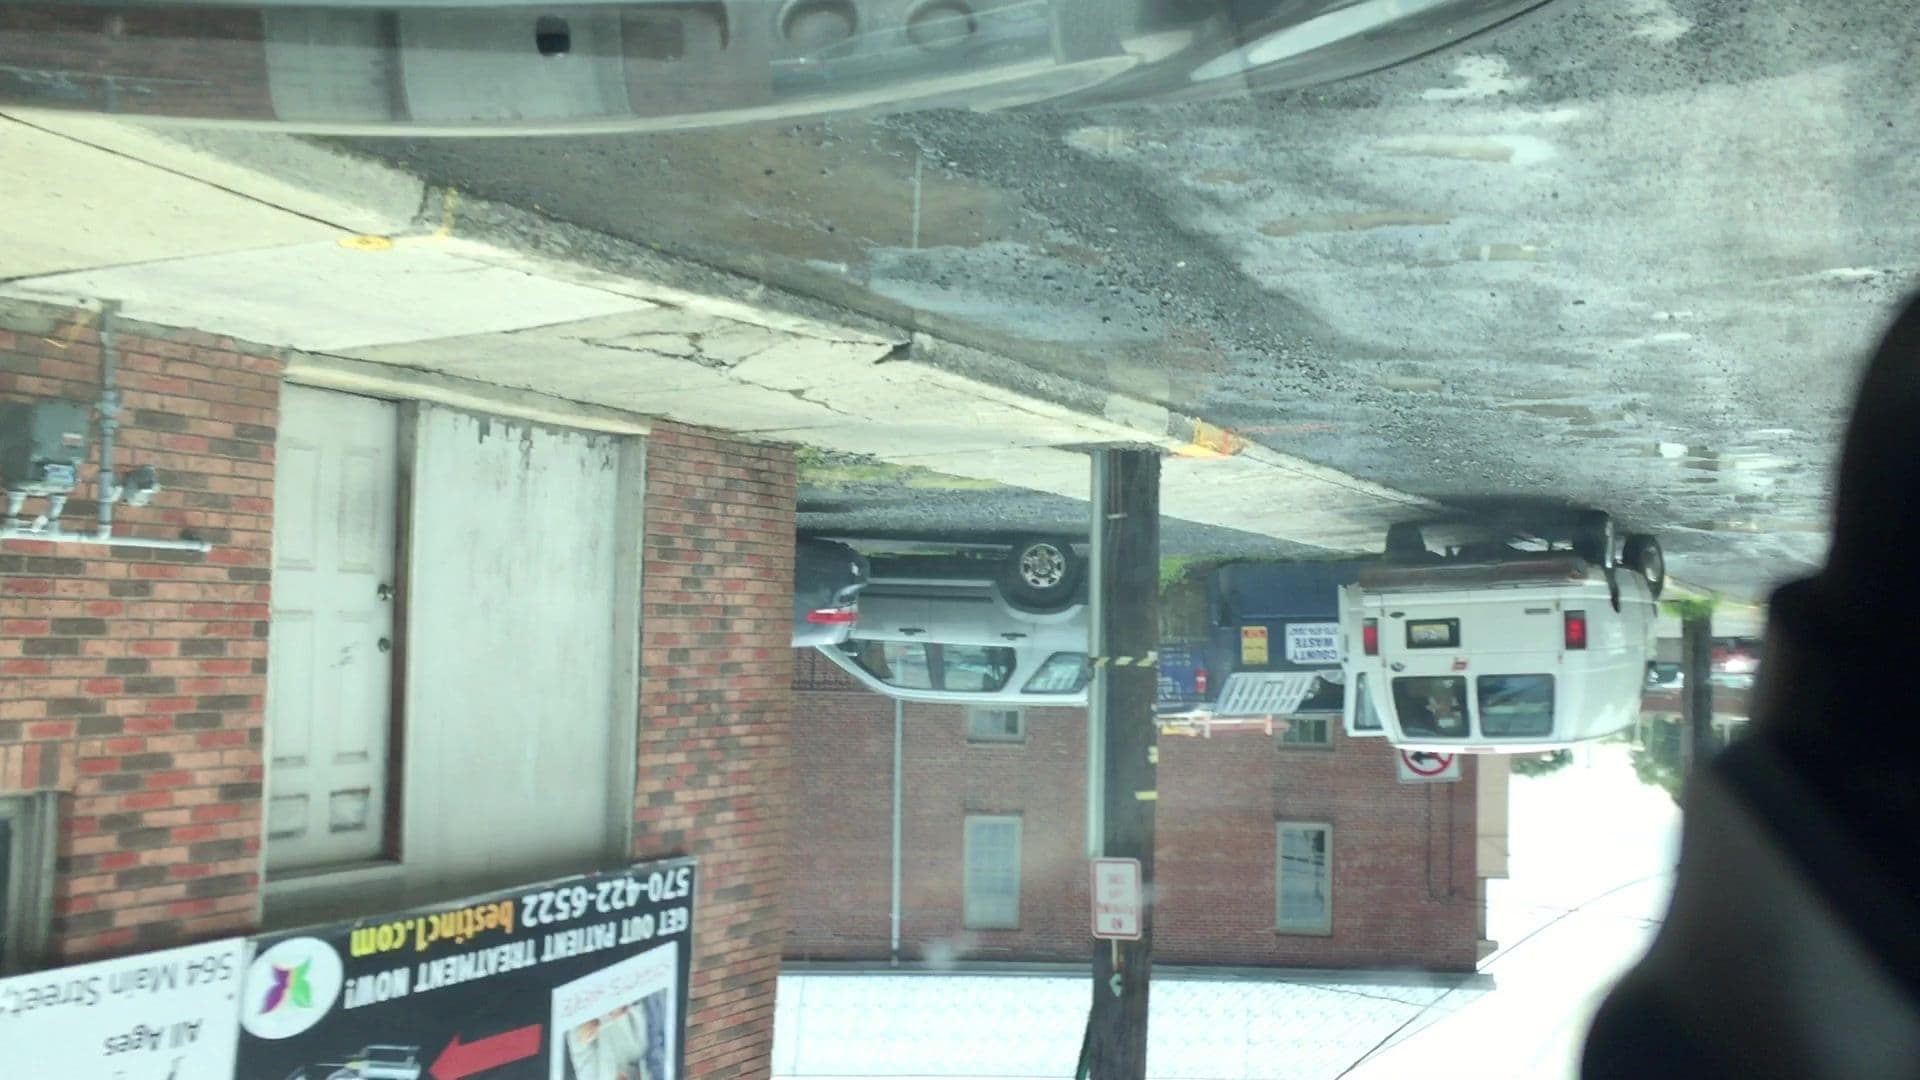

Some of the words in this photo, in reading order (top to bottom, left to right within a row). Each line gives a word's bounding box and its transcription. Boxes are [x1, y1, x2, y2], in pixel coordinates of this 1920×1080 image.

[1293, 649, 1337, 660] COUNTY
[1295, 638, 1334, 649] WASTE
[521, 867, 691, 927] 570-422-6522
[350, 900, 515, 958] bestinc1.com
[619, 914, 655, 944] OUT
[656, 907, 688, 936] GET
[540, 921, 617, 962] PATIENT
[109, 962, 178, 999] Main
[186, 953, 233, 985] 564
[413, 939, 537, 992] TREATMENT
[344, 967, 410, 1009] NOW!
[103, 1024, 165, 1056] Ages
[170, 1019, 203, 1048] All
